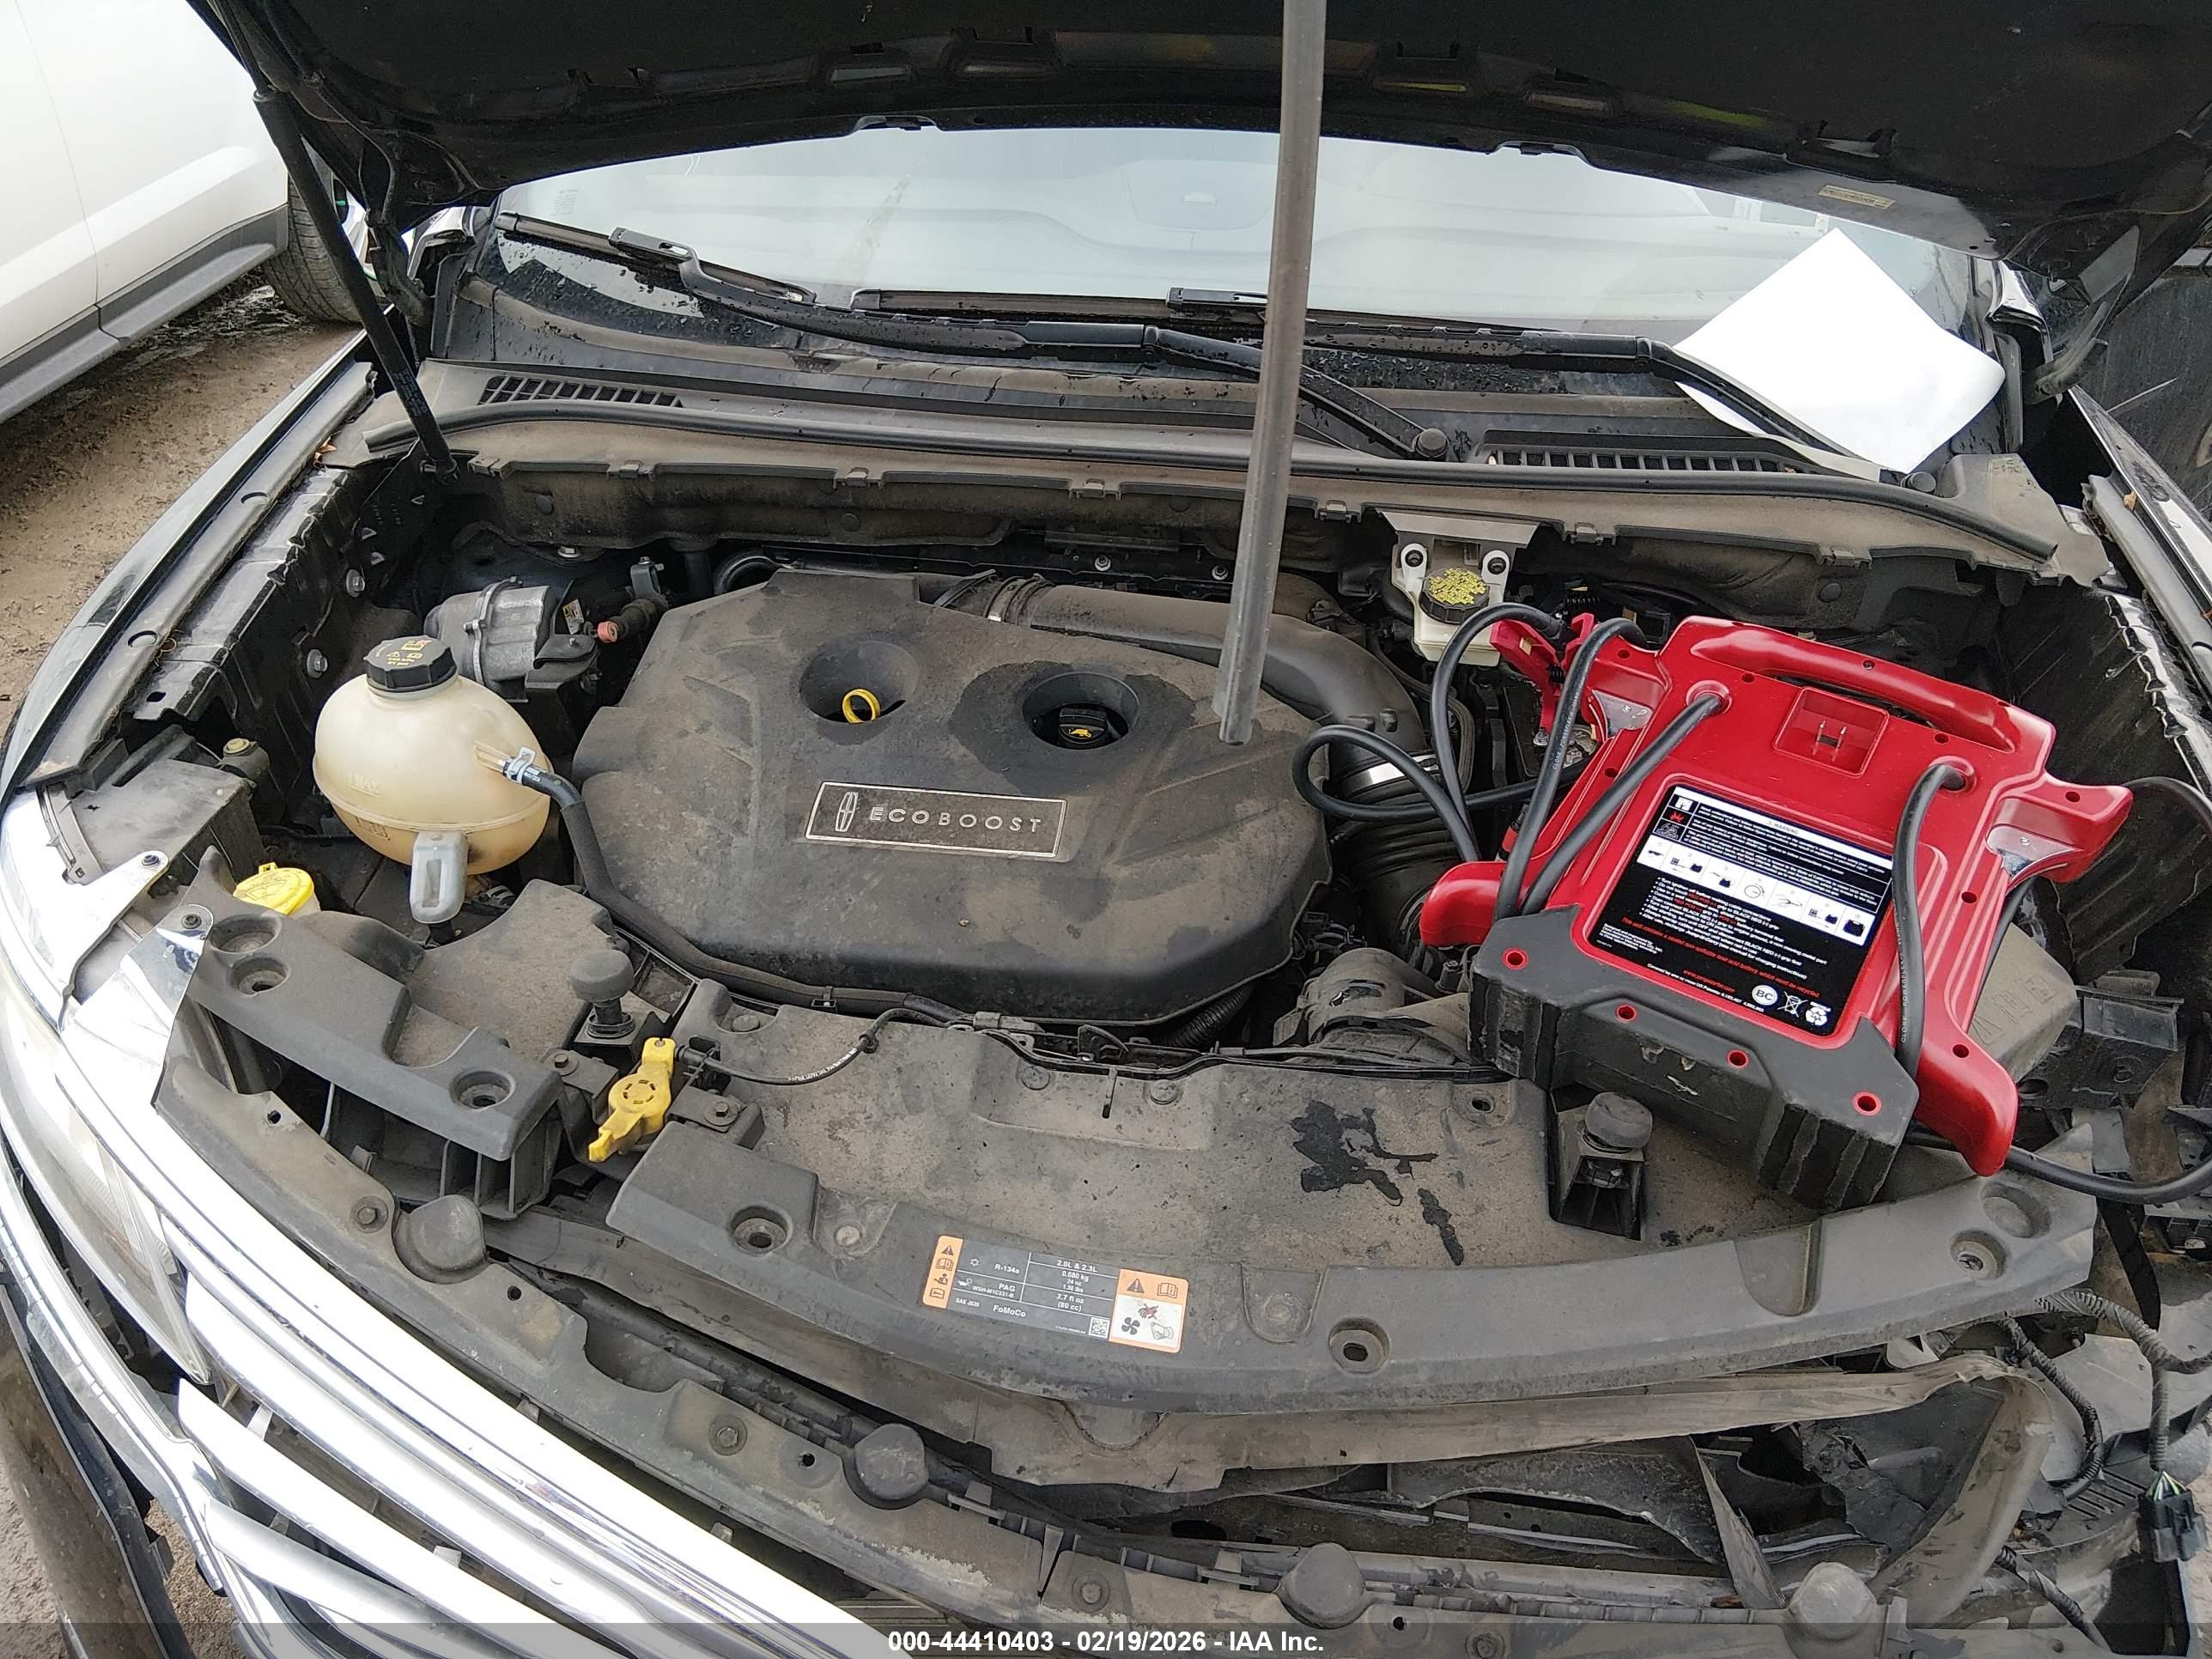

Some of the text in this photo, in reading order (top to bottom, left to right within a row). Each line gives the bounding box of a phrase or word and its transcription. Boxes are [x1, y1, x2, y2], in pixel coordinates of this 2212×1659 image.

[869, 806, 1042, 833] ECOBOOST
[1755, 989, 1774, 1001] BC
[994, 1263, 1020, 1274] R-134a
[1056, 1260, 1073, 1268] 2.0L
[1081, 1264, 1097, 1273] 2.3L
[1061, 1270, 1090, 1283] 0.680 kg
[998, 1283, 1016, 1292] PAG
[993, 1304, 1026, 1317] FoMoCo
[1070, 1304, 1082, 1313] cc)
